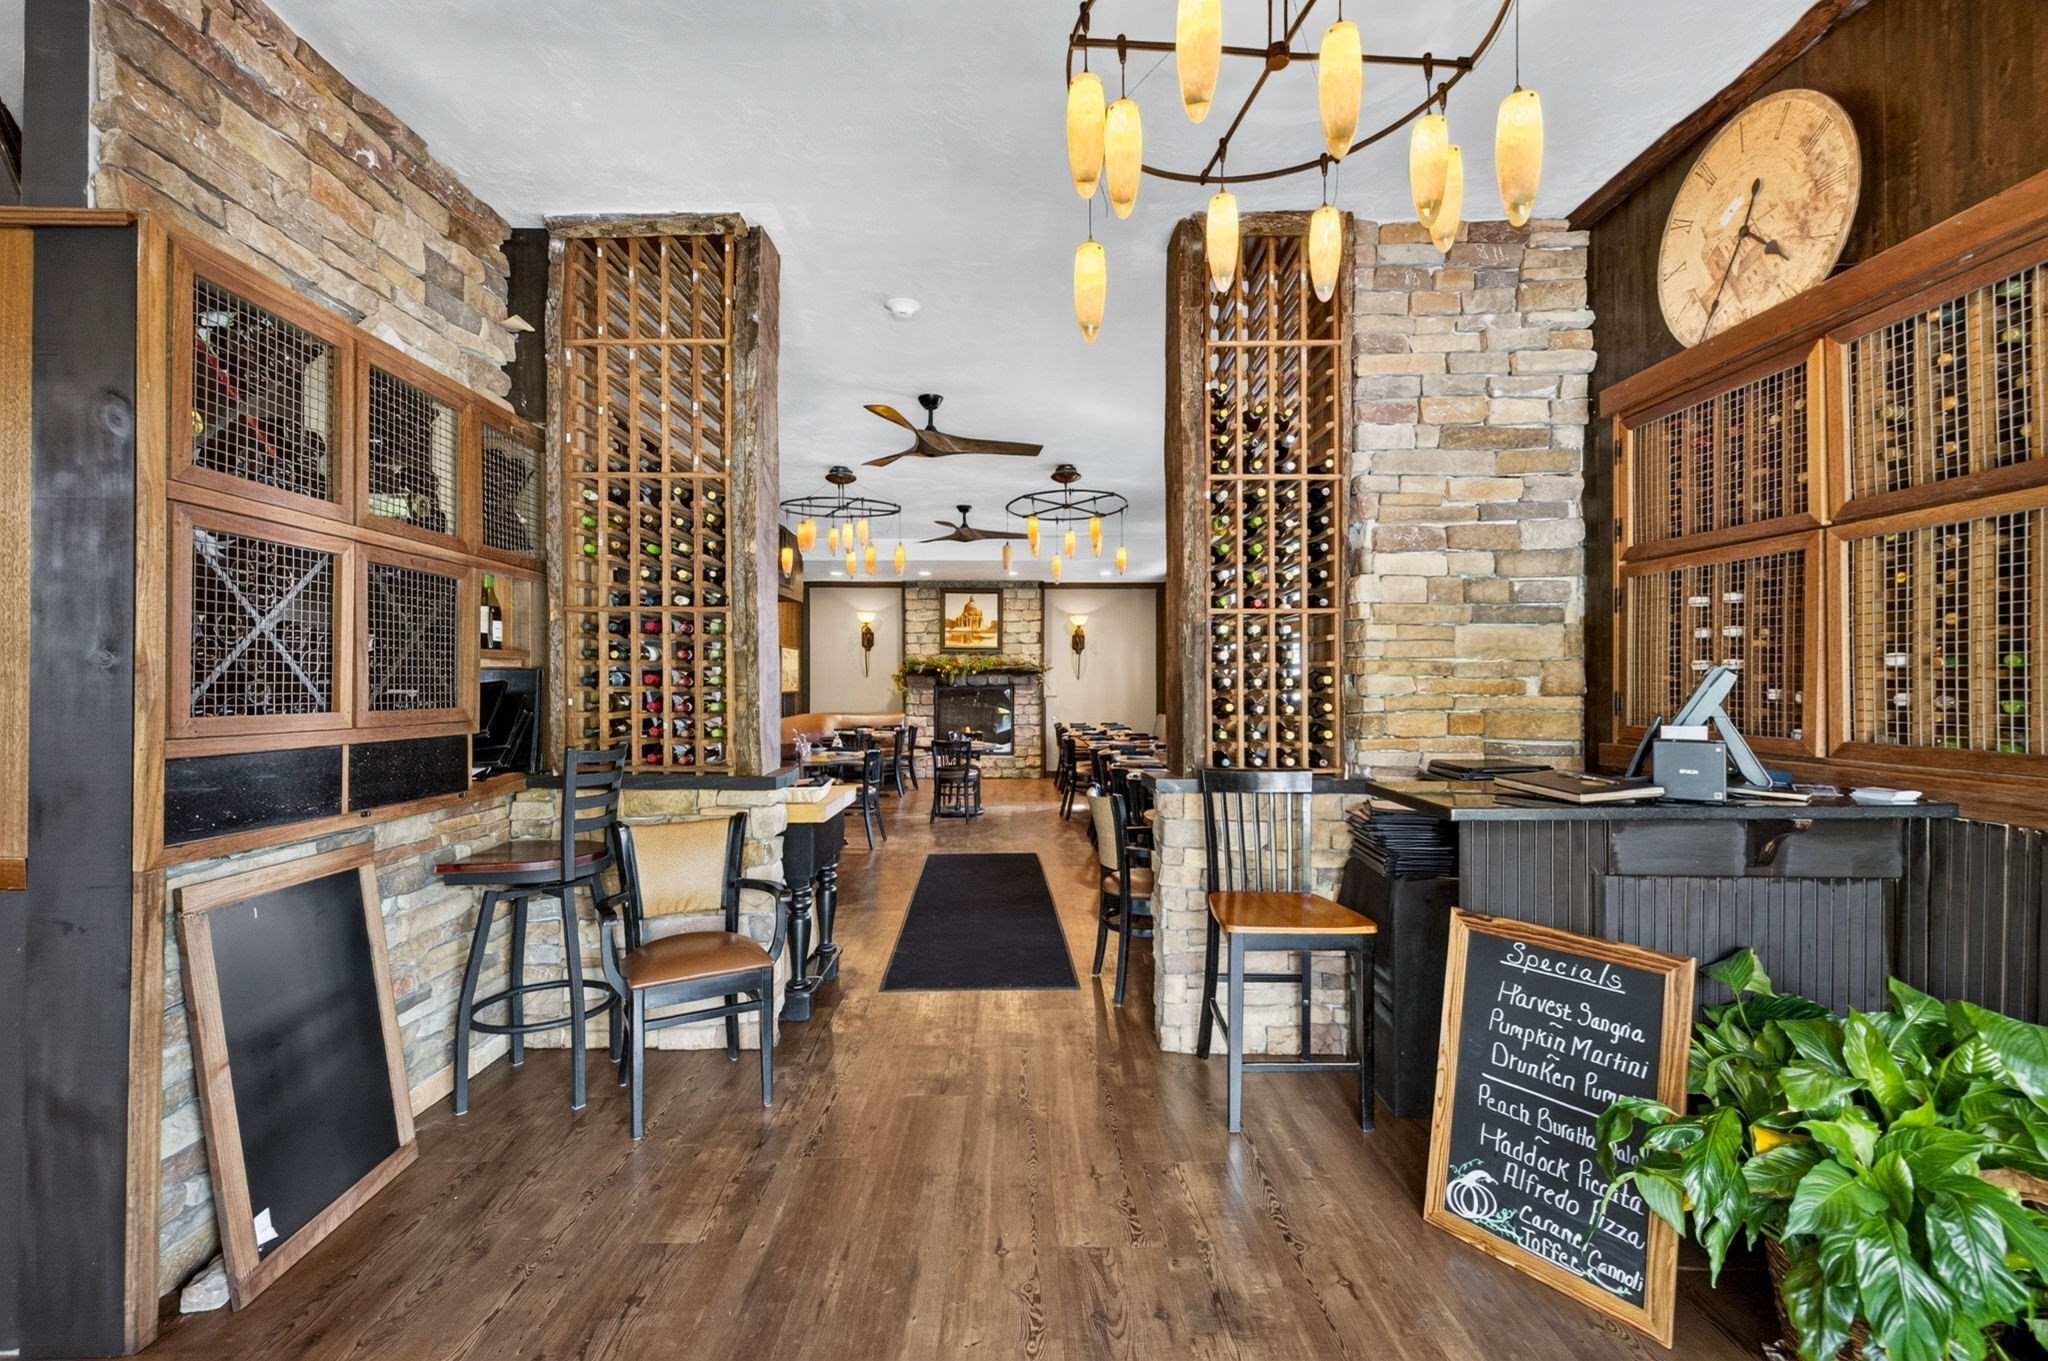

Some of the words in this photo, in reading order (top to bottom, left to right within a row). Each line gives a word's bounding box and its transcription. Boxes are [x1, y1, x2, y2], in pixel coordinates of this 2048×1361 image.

[1506, 942, 1622, 990] Specials
[1497, 980, 1573, 1022] Harvest
[1577, 1003, 1645, 1044] Sangria
[1489, 1008, 1566, 1054] Pumpkin
[1571, 1039, 1649, 1079] Martini
[1478, 1084, 1531, 1126] Peach
[1480, 1123, 1568, 1182] Haddock
[1503, 1162, 1580, 1216] Alfredo
[1587, 1250, 1644, 1292] Cannoli
